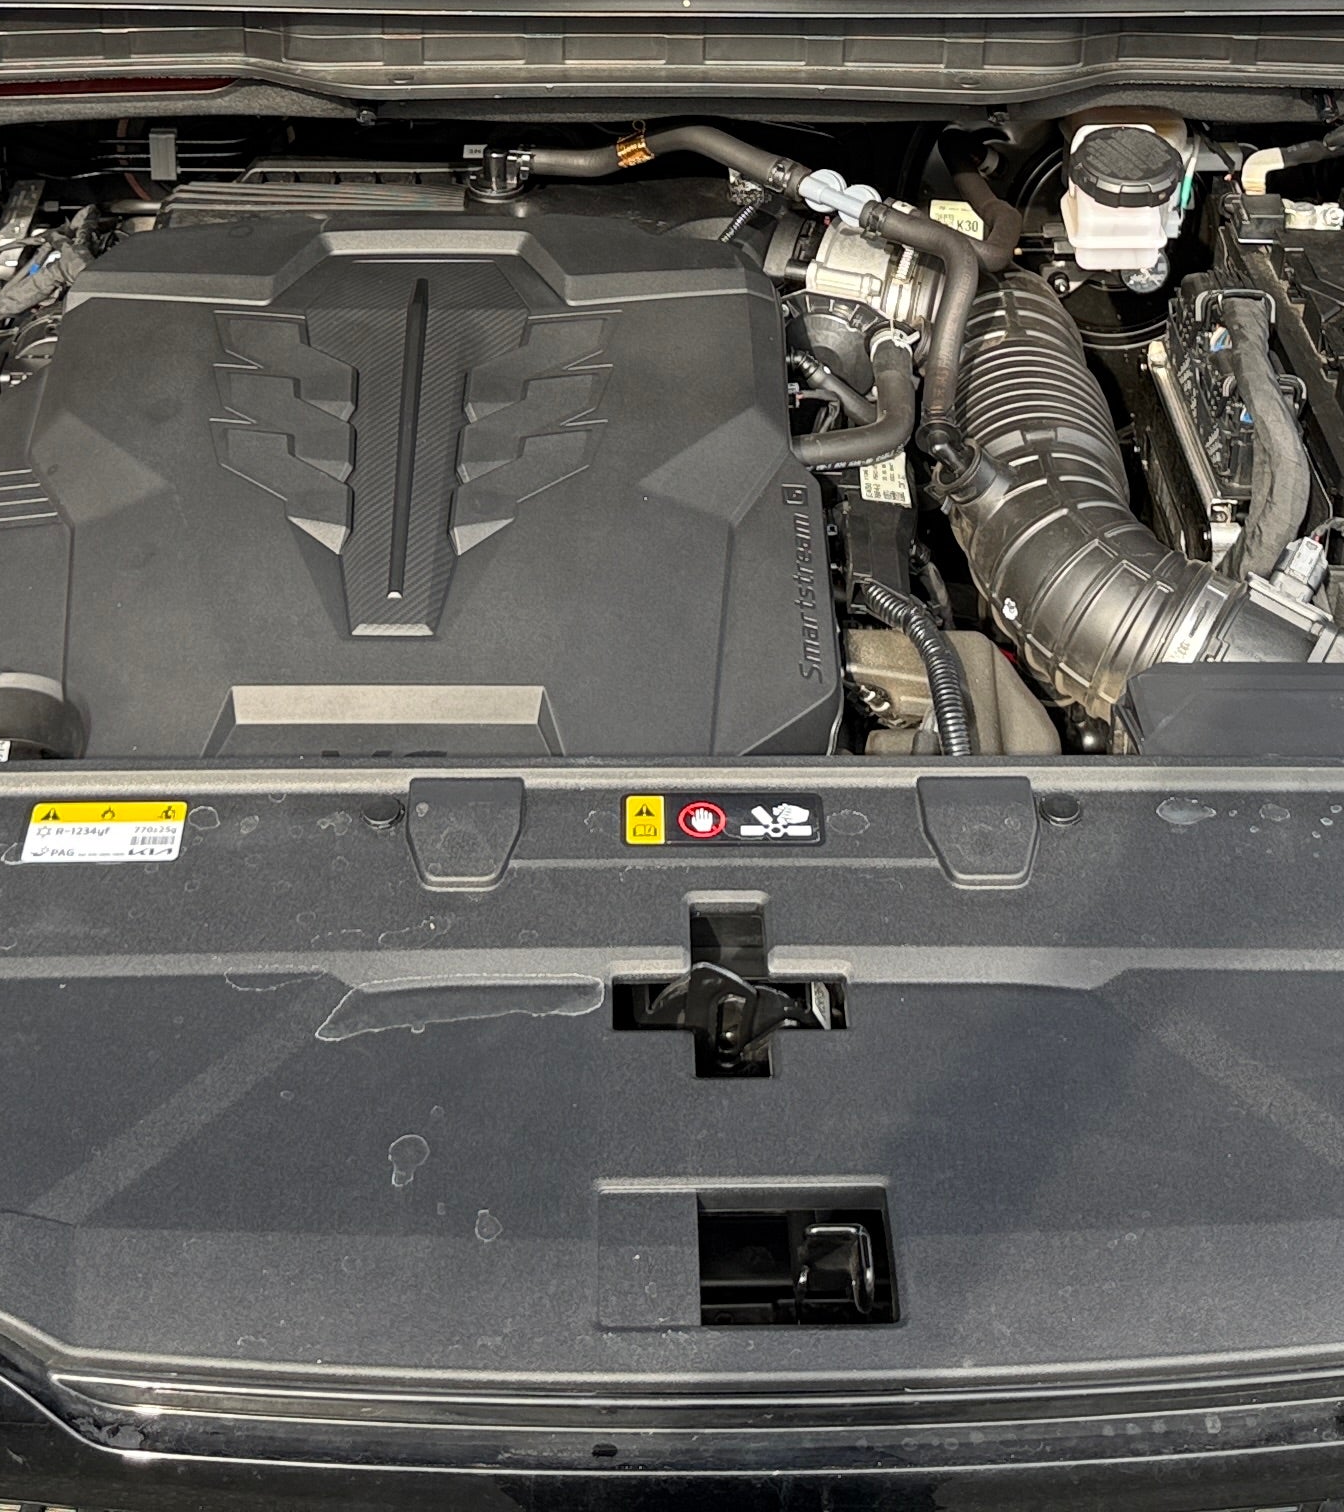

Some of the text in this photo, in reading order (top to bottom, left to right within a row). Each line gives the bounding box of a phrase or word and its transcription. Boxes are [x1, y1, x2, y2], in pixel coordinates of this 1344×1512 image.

[957, 220, 978, 232] K30
[793, 512, 823, 684] Smartstream
[56, 826, 110, 836] R-1234yf
[50, 848, 75, 856] PAG
